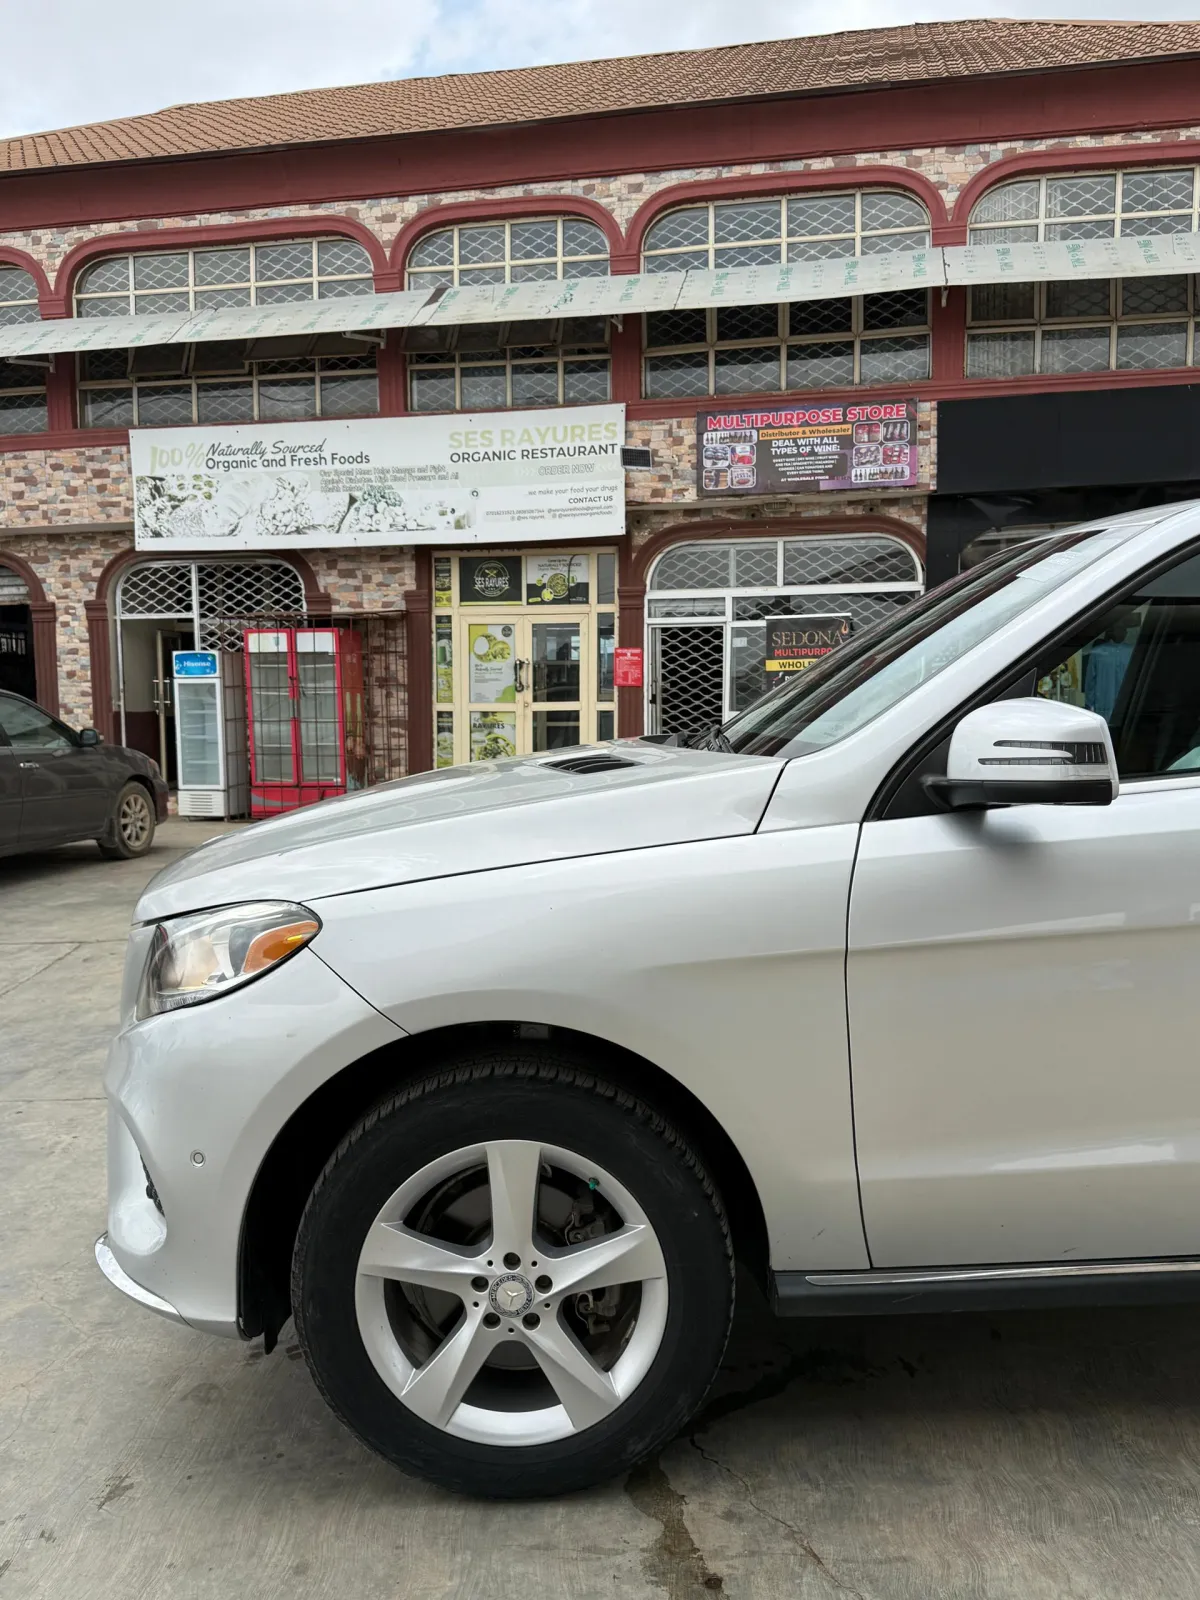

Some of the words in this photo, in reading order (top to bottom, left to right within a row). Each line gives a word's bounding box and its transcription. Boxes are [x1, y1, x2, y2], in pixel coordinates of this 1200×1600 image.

[707, 408, 842, 430] MULTIPURPOSE
[846, 404, 906, 421] STORE
[449, 429, 494, 449] SES
[500, 422, 618, 447] RAYURES
[151, 442, 205, 474] 100%
[206, 441, 266, 460] Naturally
[271, 438, 327, 454] Sourced
[450, 450, 516, 463] ORGANIC
[521, 443, 618, 460] RESTAURANT
[771, 446, 798, 455] TYPES
[814, 444, 840, 453] WINE:
[206, 455, 257, 472] Organic
[262, 453, 287, 468] and
[290, 453, 327, 466] Fresh
[331, 452, 370, 465] Foods
[538, 465, 570, 476] ORDER
[571, 463, 595, 473] NOW
[585, 486, 599, 494] your
[475, 577, 485, 588] SES
[485, 577, 509, 588] RAYURES
[772, 630, 844, 646] SEDONA
